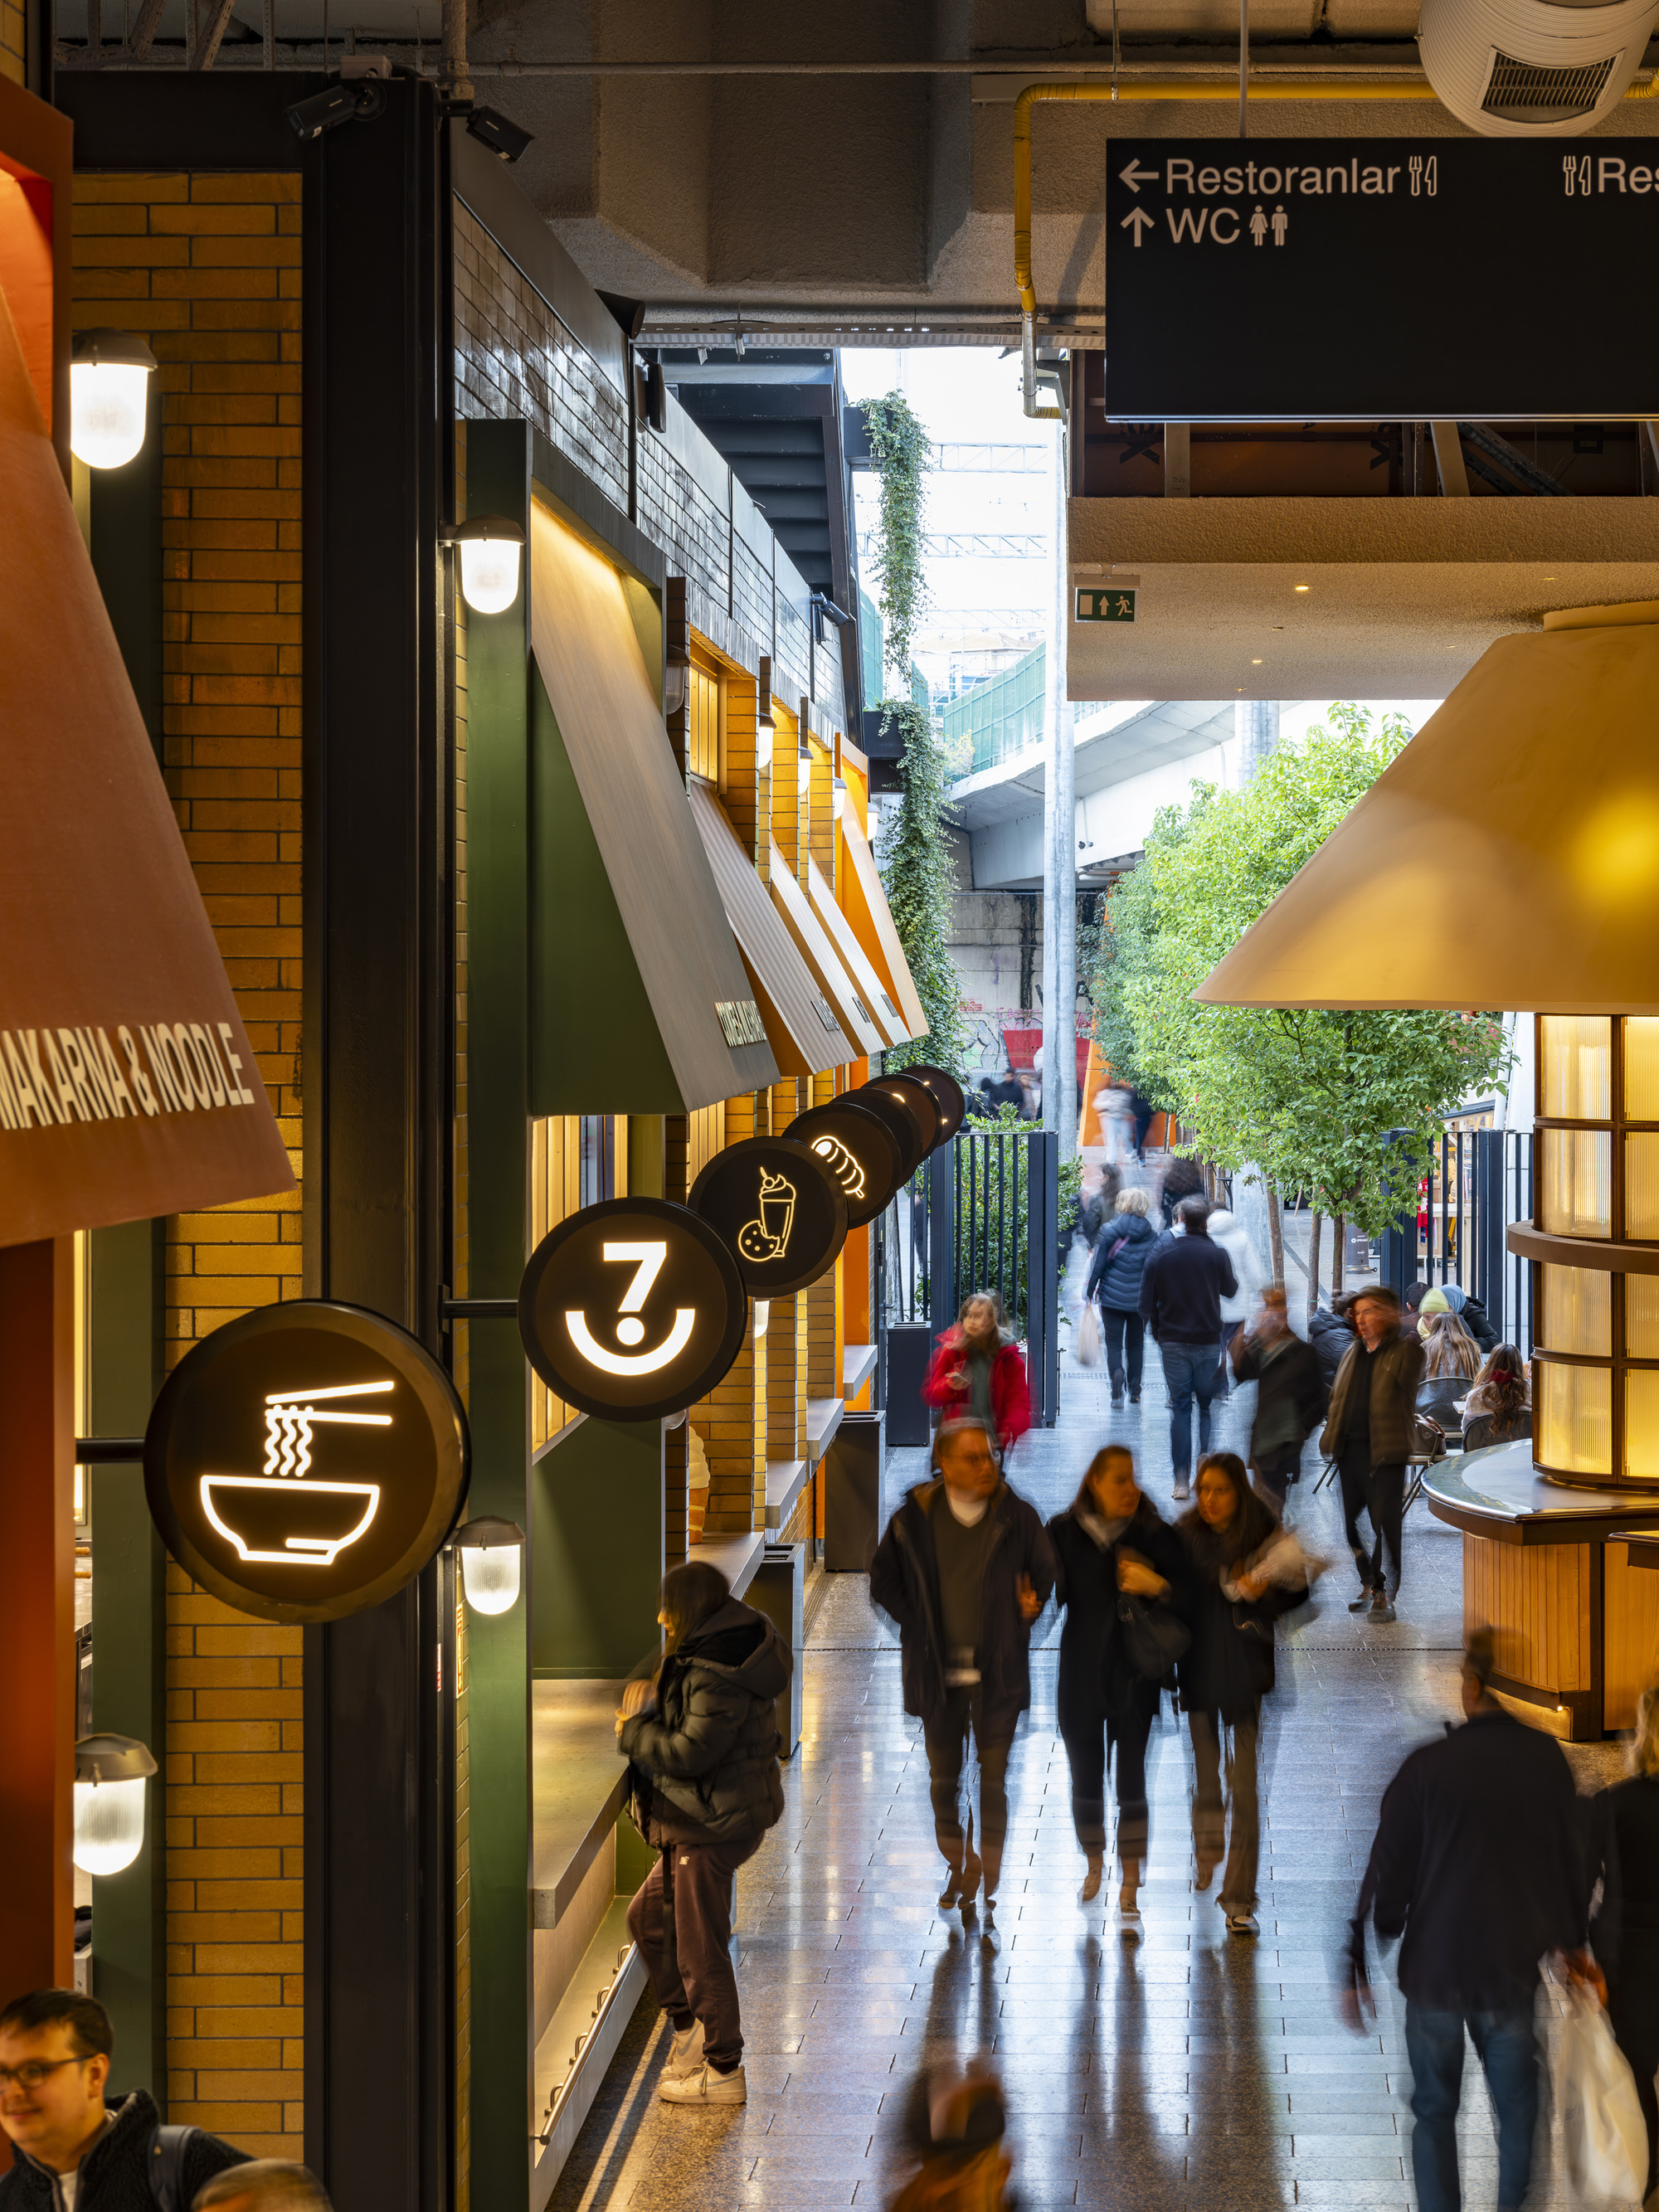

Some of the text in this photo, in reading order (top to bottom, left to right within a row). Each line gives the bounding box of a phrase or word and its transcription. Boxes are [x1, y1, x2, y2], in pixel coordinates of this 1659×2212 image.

[1166, 158, 1401, 195] Restoranlar
[1598, 158, 1659, 194] Re
[1165, 207, 1241, 245] WC
[0, 1022, 255, 1130] MAKARNA & NOODLE
[603, 1242, 667, 1313] 7
